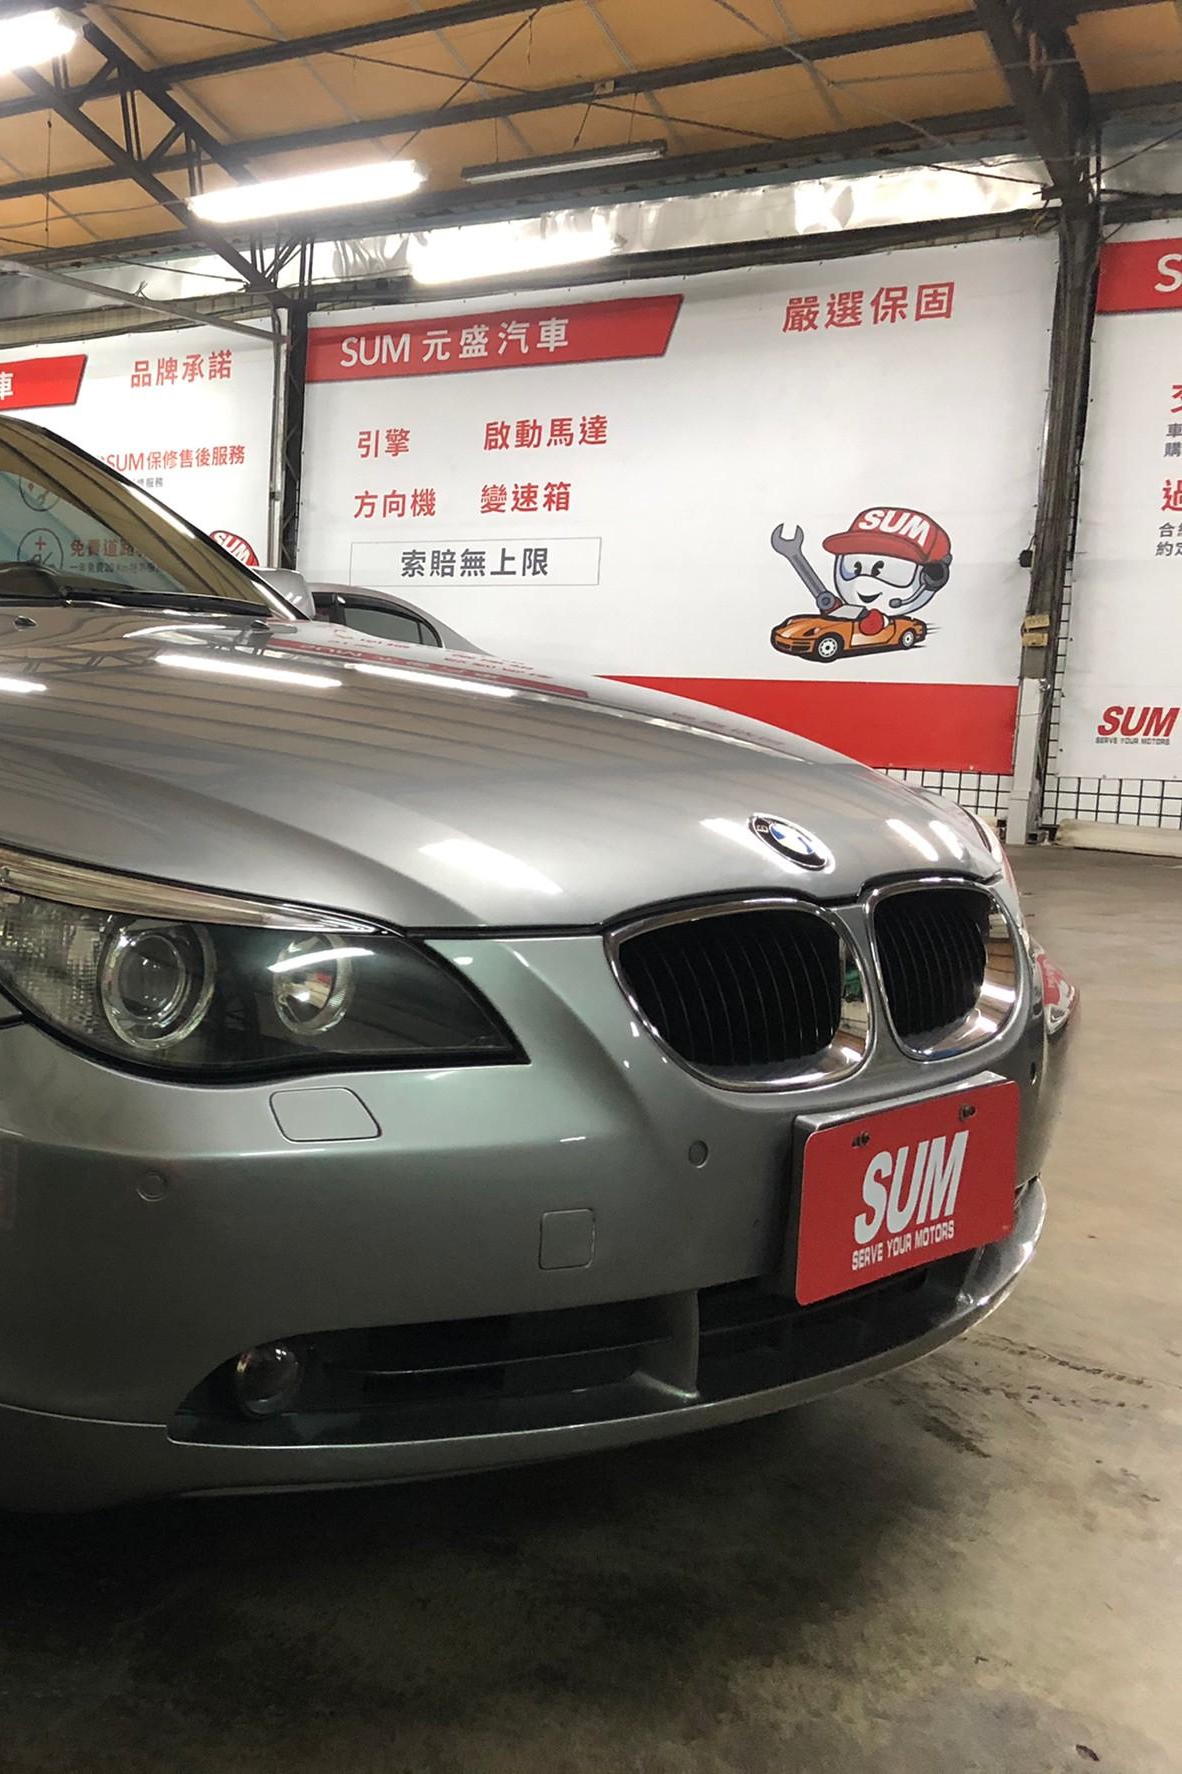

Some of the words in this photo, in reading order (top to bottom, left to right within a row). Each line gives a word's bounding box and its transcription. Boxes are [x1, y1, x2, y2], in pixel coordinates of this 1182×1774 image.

[782, 282, 955, 333] 嚴選保固
[341, 333, 411, 367] SUM
[423, 318, 569, 362] 元盛汽車
[130, 349, 232, 388] 品牌承諾
[357, 428, 411, 458] 引擎
[483, 415, 609, 451] 啟動馬達
[353, 488, 437, 519] 方向機
[480, 481, 572, 514] 變速箱
[858, 509, 930, 547] SUM
[400, 547, 549, 578] 索賠無上限
[1097, 705, 1180, 737] SUM
[854, 1130, 970, 1245] SUM
[851, 1241, 884, 1271] SERVE
[886, 1233, 912, 1258] YOUR
[914, 1220, 955, 1249] MOTORS
